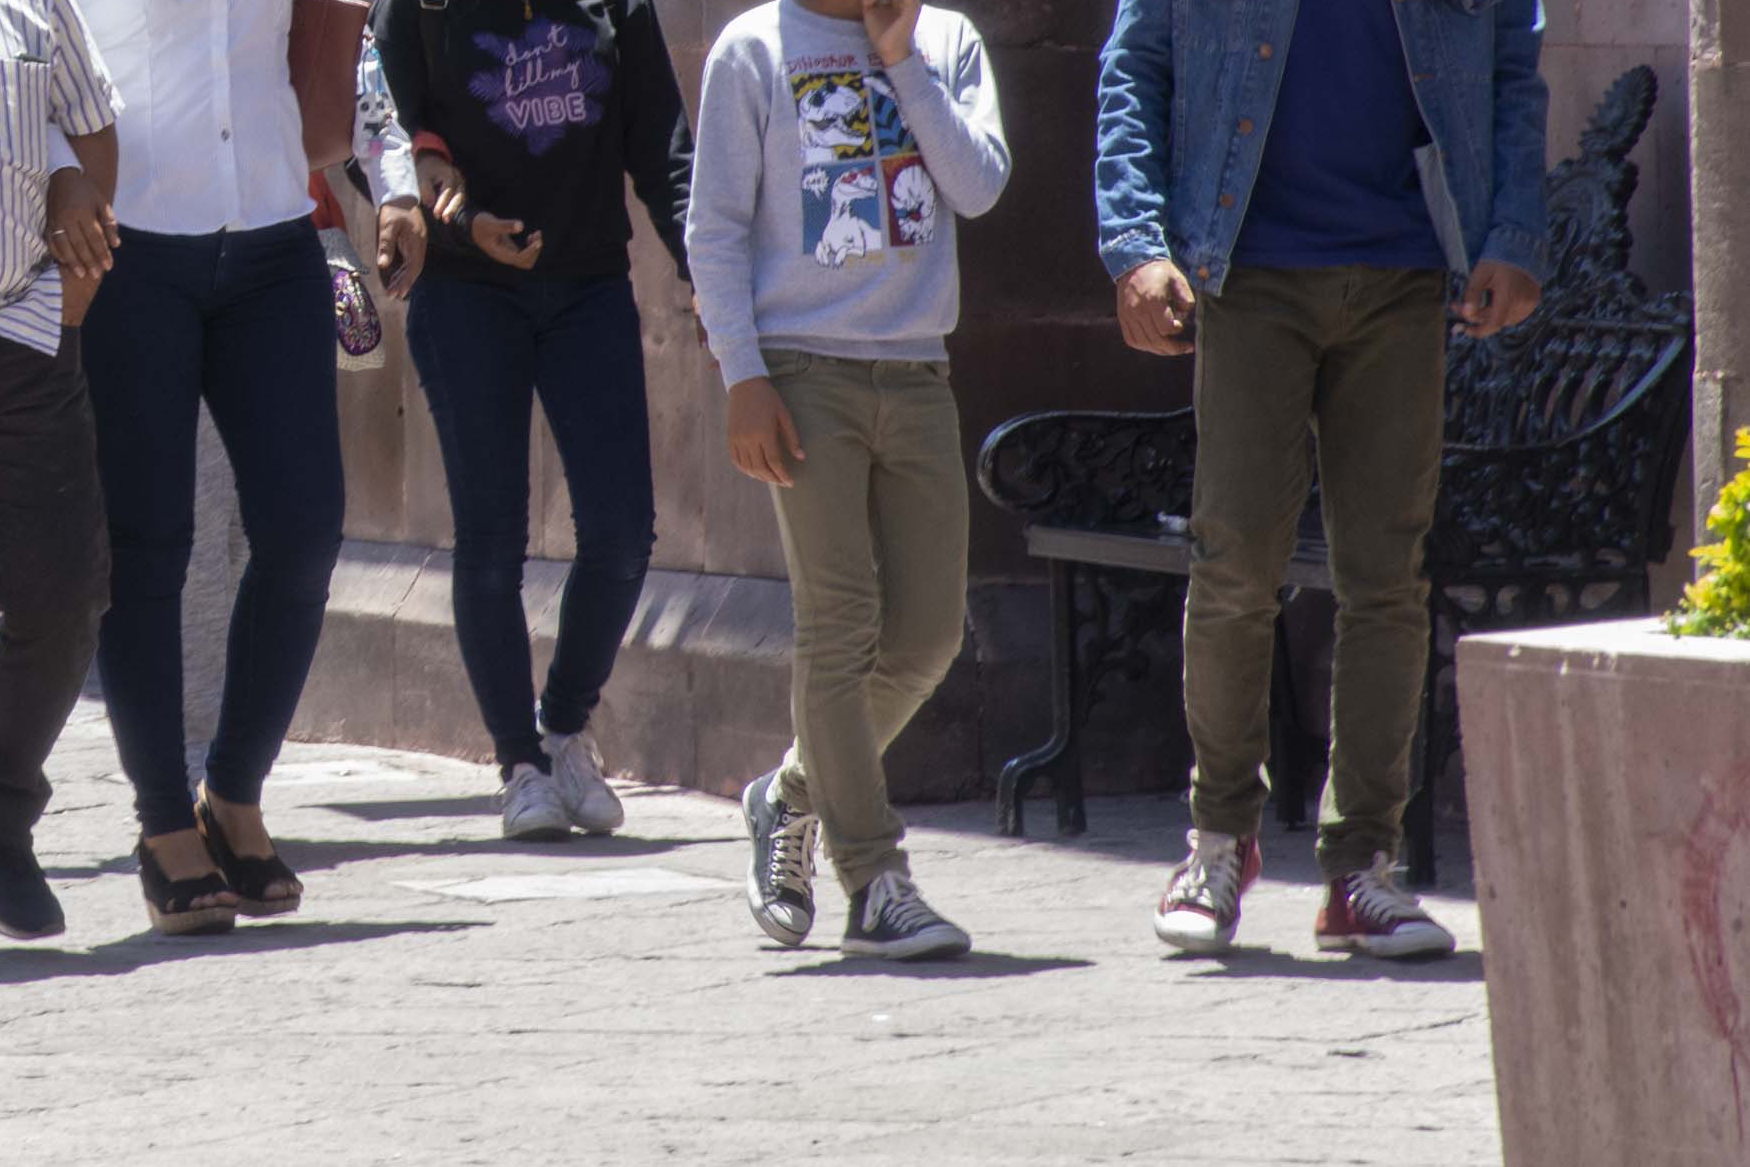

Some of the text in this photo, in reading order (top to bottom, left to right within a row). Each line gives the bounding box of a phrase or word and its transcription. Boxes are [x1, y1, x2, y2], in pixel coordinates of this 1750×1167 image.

[505, 56, 581, 99] kill my
[505, 91, 587, 130] VIBE
